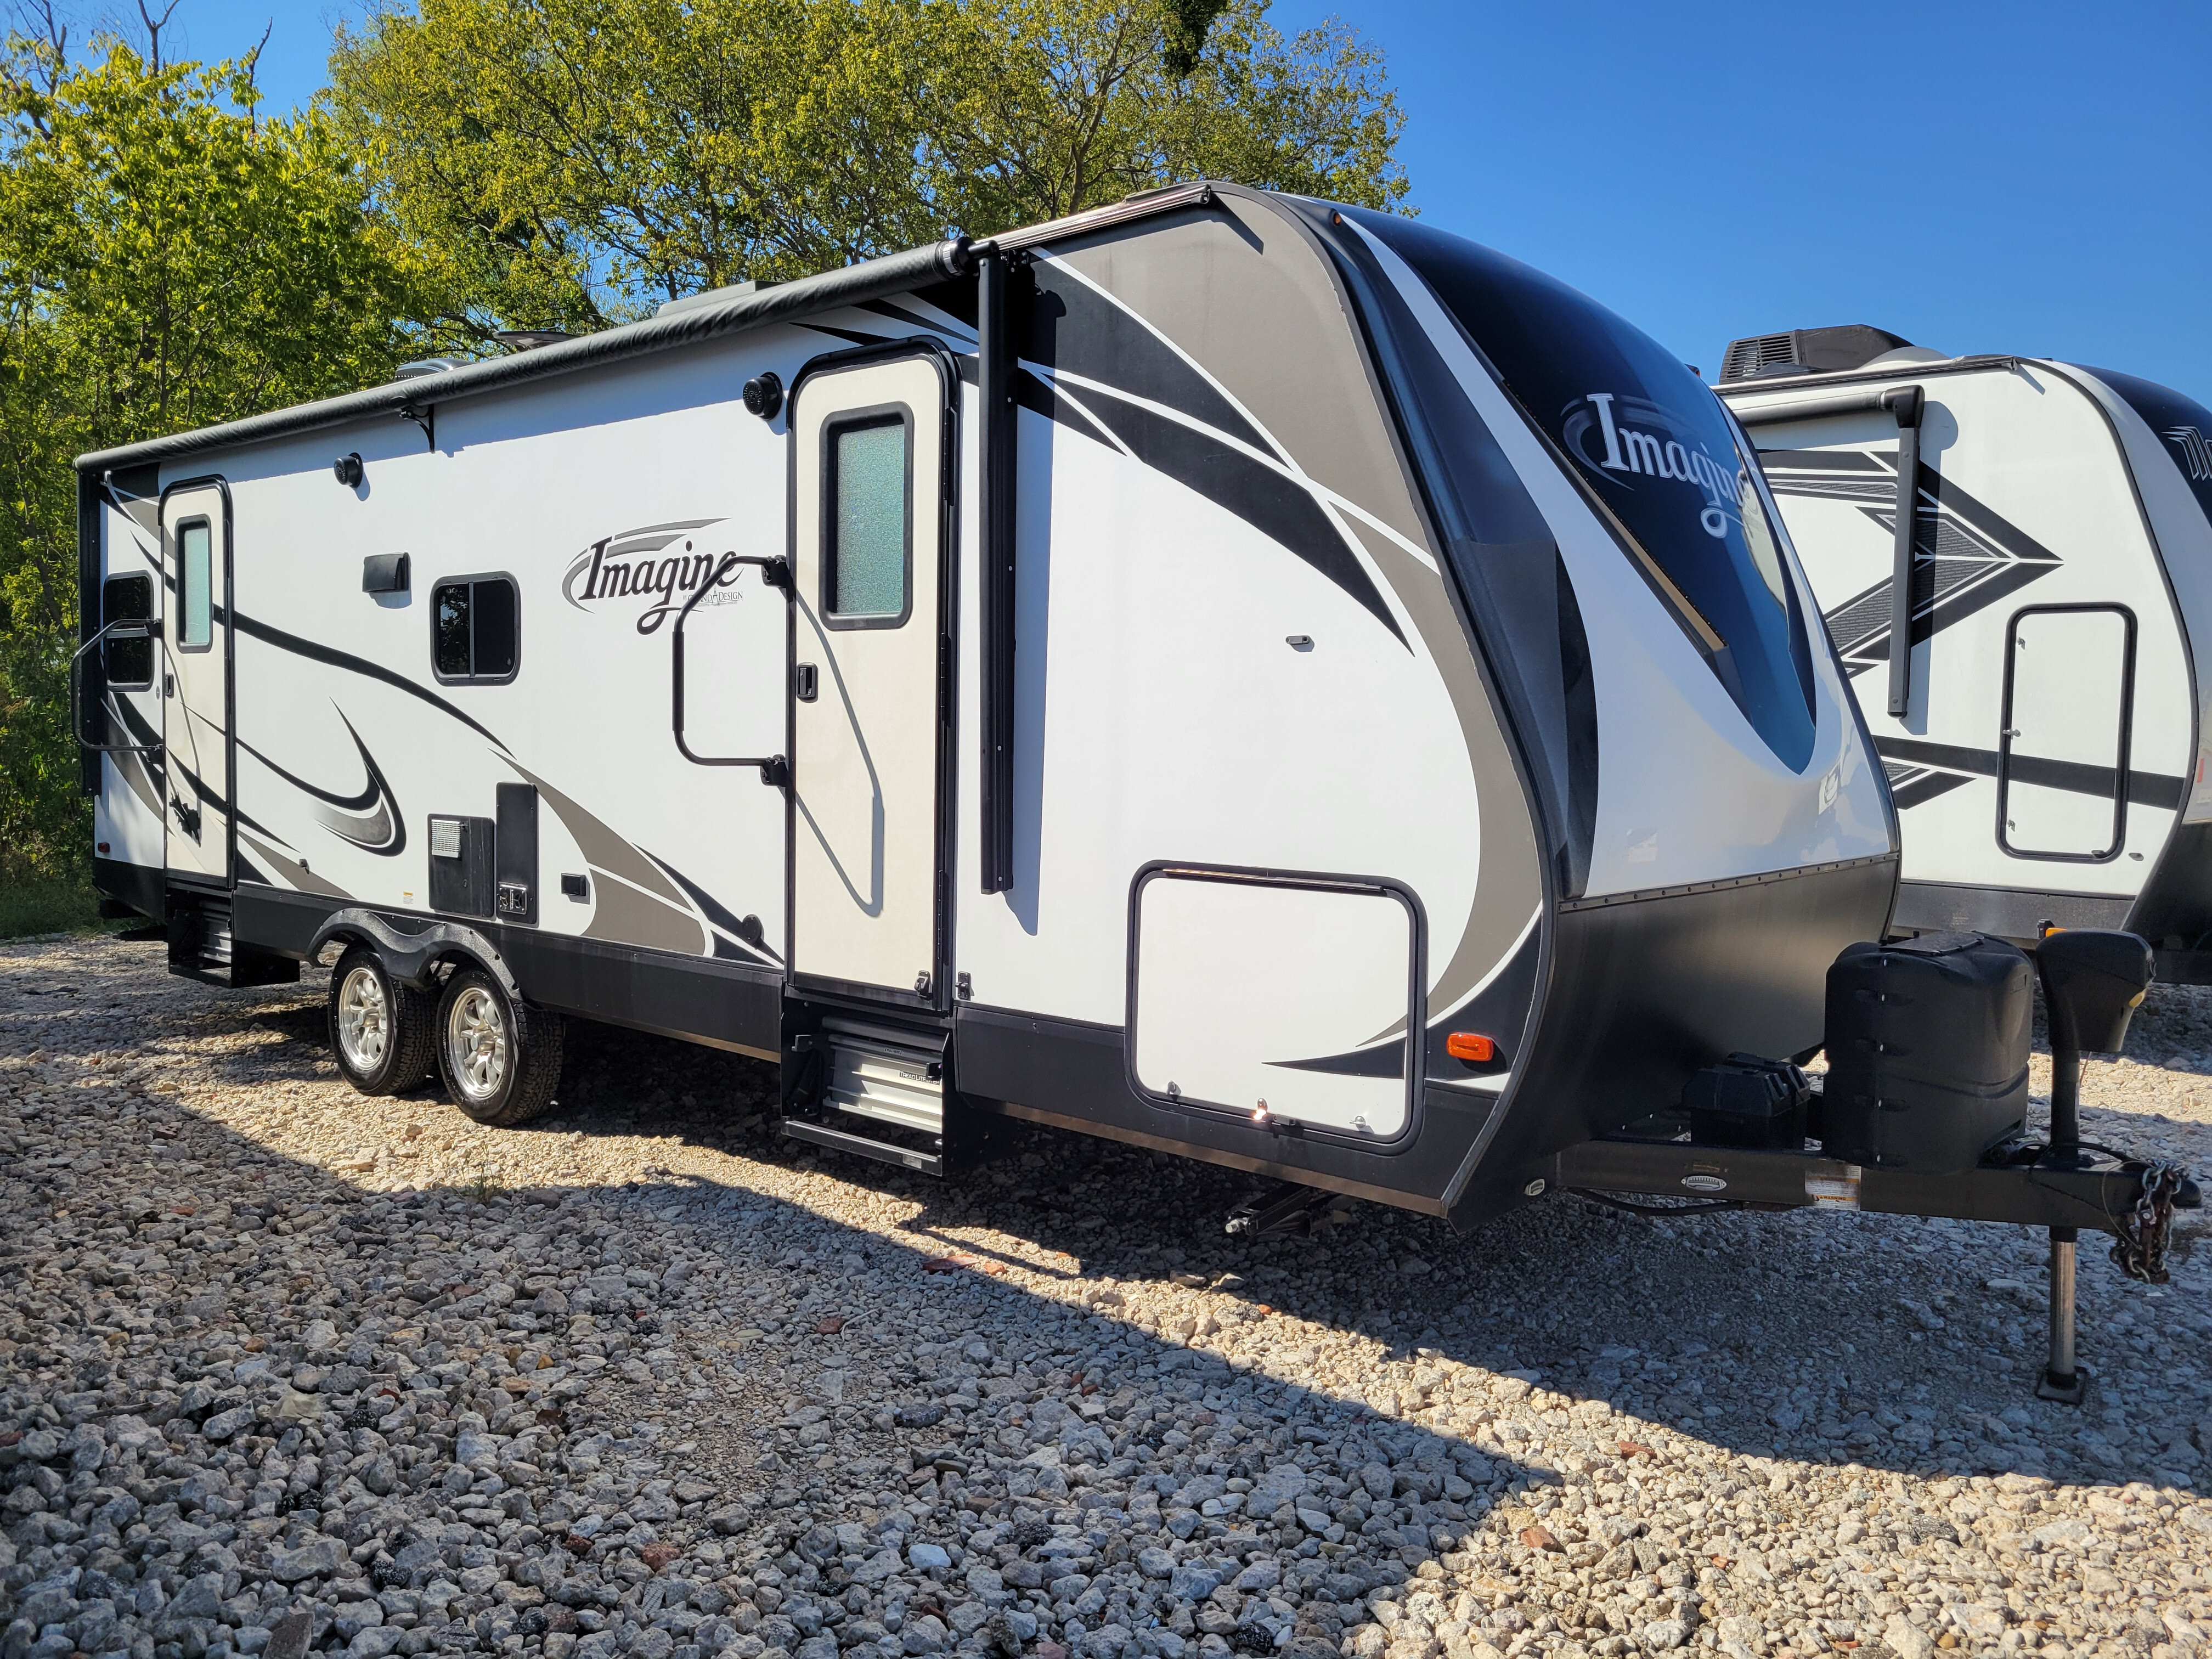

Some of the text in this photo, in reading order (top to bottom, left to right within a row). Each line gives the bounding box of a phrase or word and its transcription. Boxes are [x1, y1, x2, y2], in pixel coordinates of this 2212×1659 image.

[1587, 393, 1758, 539] Imagine
[578, 537, 744, 635] Imagine
[718, 591, 743, 601] DESIGN
[900, 1071, 916, 1080] TREAD
